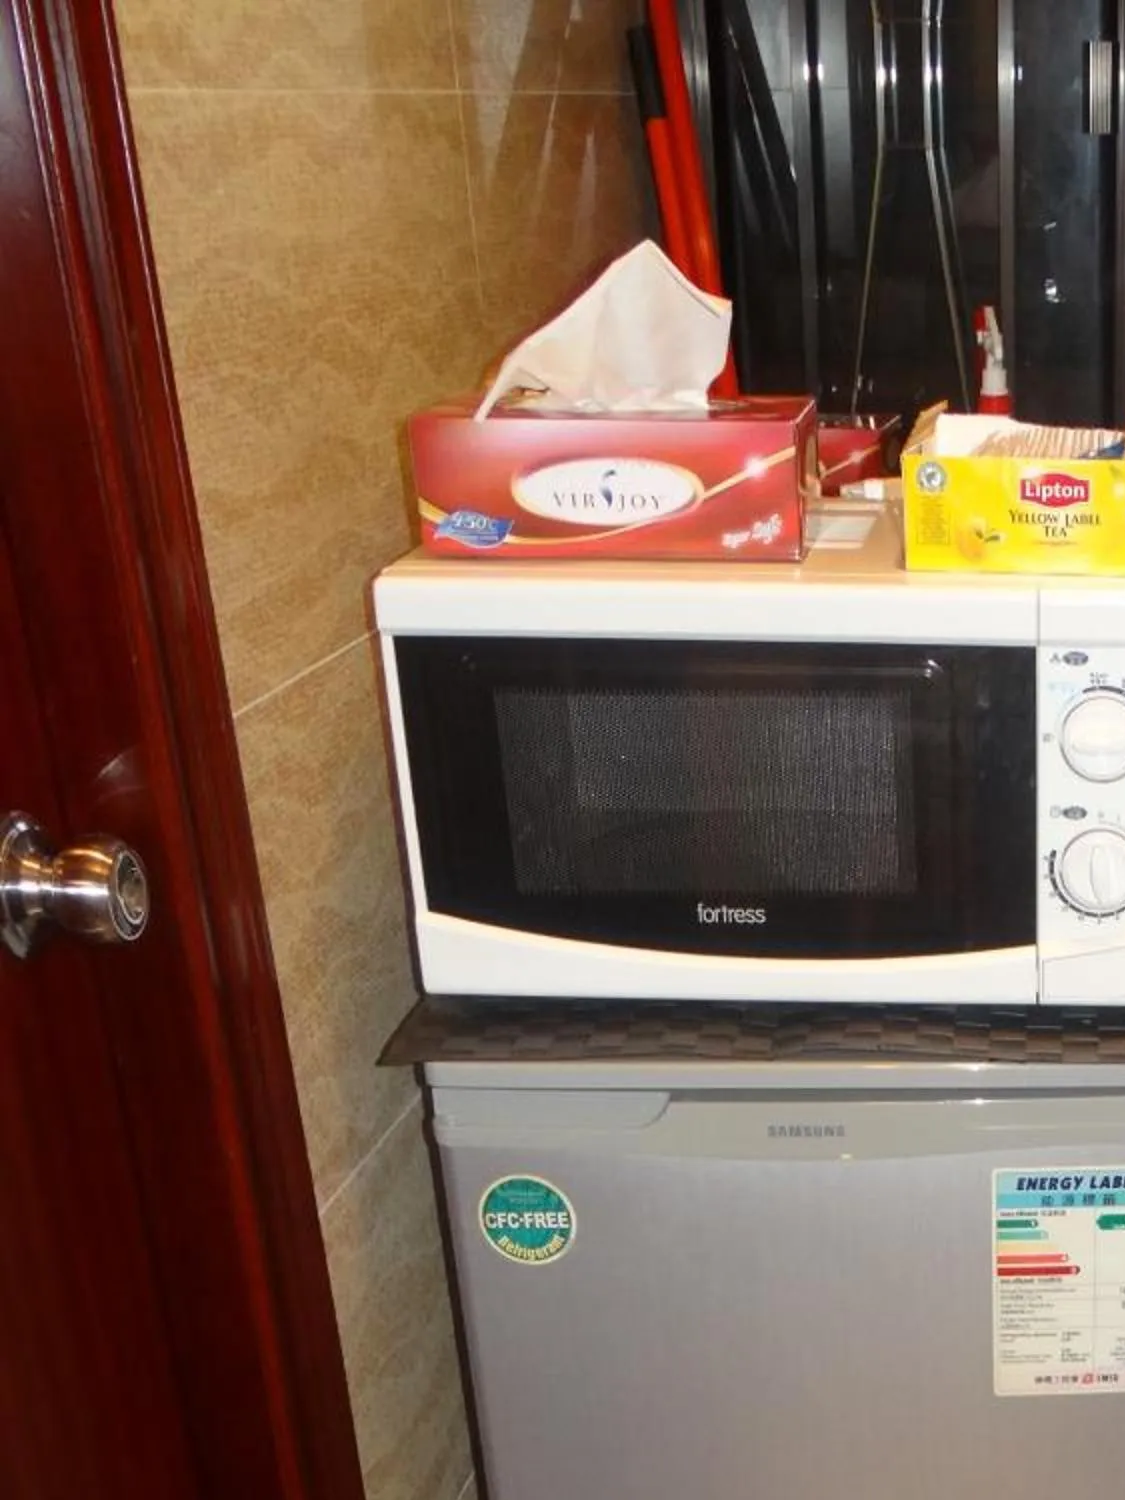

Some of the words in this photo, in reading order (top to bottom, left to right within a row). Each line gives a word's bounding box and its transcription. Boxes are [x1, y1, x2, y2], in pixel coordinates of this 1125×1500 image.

[1024, 480, 1086, 503] Lipton
[1008, 509, 1059, 525] YELLOW
[1064, 512, 1102, 529] LABEL
[1042, 525, 1068, 538] TEA
[697, 902, 767, 923] fortress
[767, 1124, 845, 1138] SAMSUNG
[1016, 1176, 1084, 1191] ENERGY
